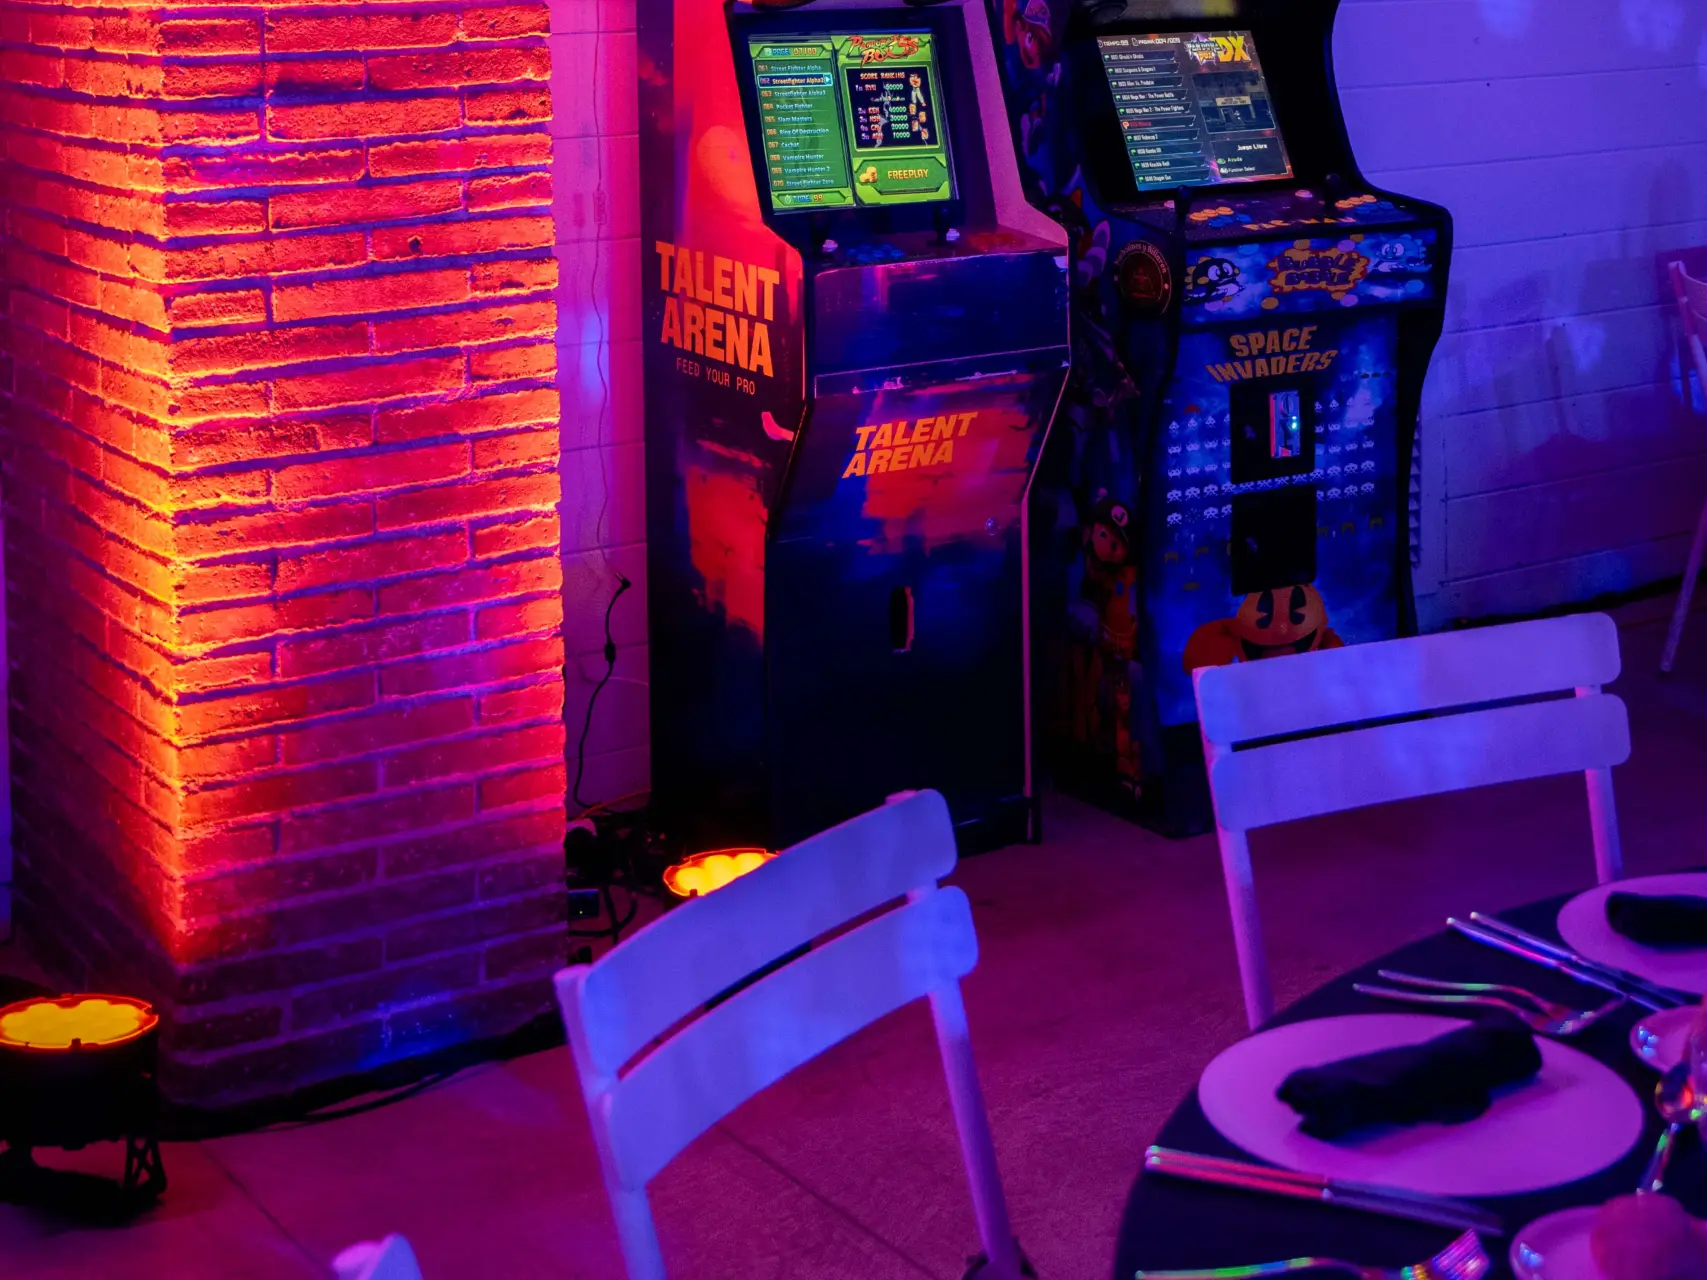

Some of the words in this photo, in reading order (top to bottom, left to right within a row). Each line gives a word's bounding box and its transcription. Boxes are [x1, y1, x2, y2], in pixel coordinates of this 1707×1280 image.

[1211, 36, 1251, 62] DX
[860, 72, 878, 80] SCORE
[887, 168, 929, 180] FREEPLAY
[655, 240, 780, 322] TALENT
[661, 296, 774, 378] ARENA
[1229, 325, 1318, 357] SPACE
[676, 357, 700, 377] FEED
[706, 367, 730, 387] YOUR
[736, 376, 756, 395] PRO
[1205, 349, 1339, 383] INVADERS
[855, 411, 979, 452] TALENT
[841, 439, 954, 479] ARENA
